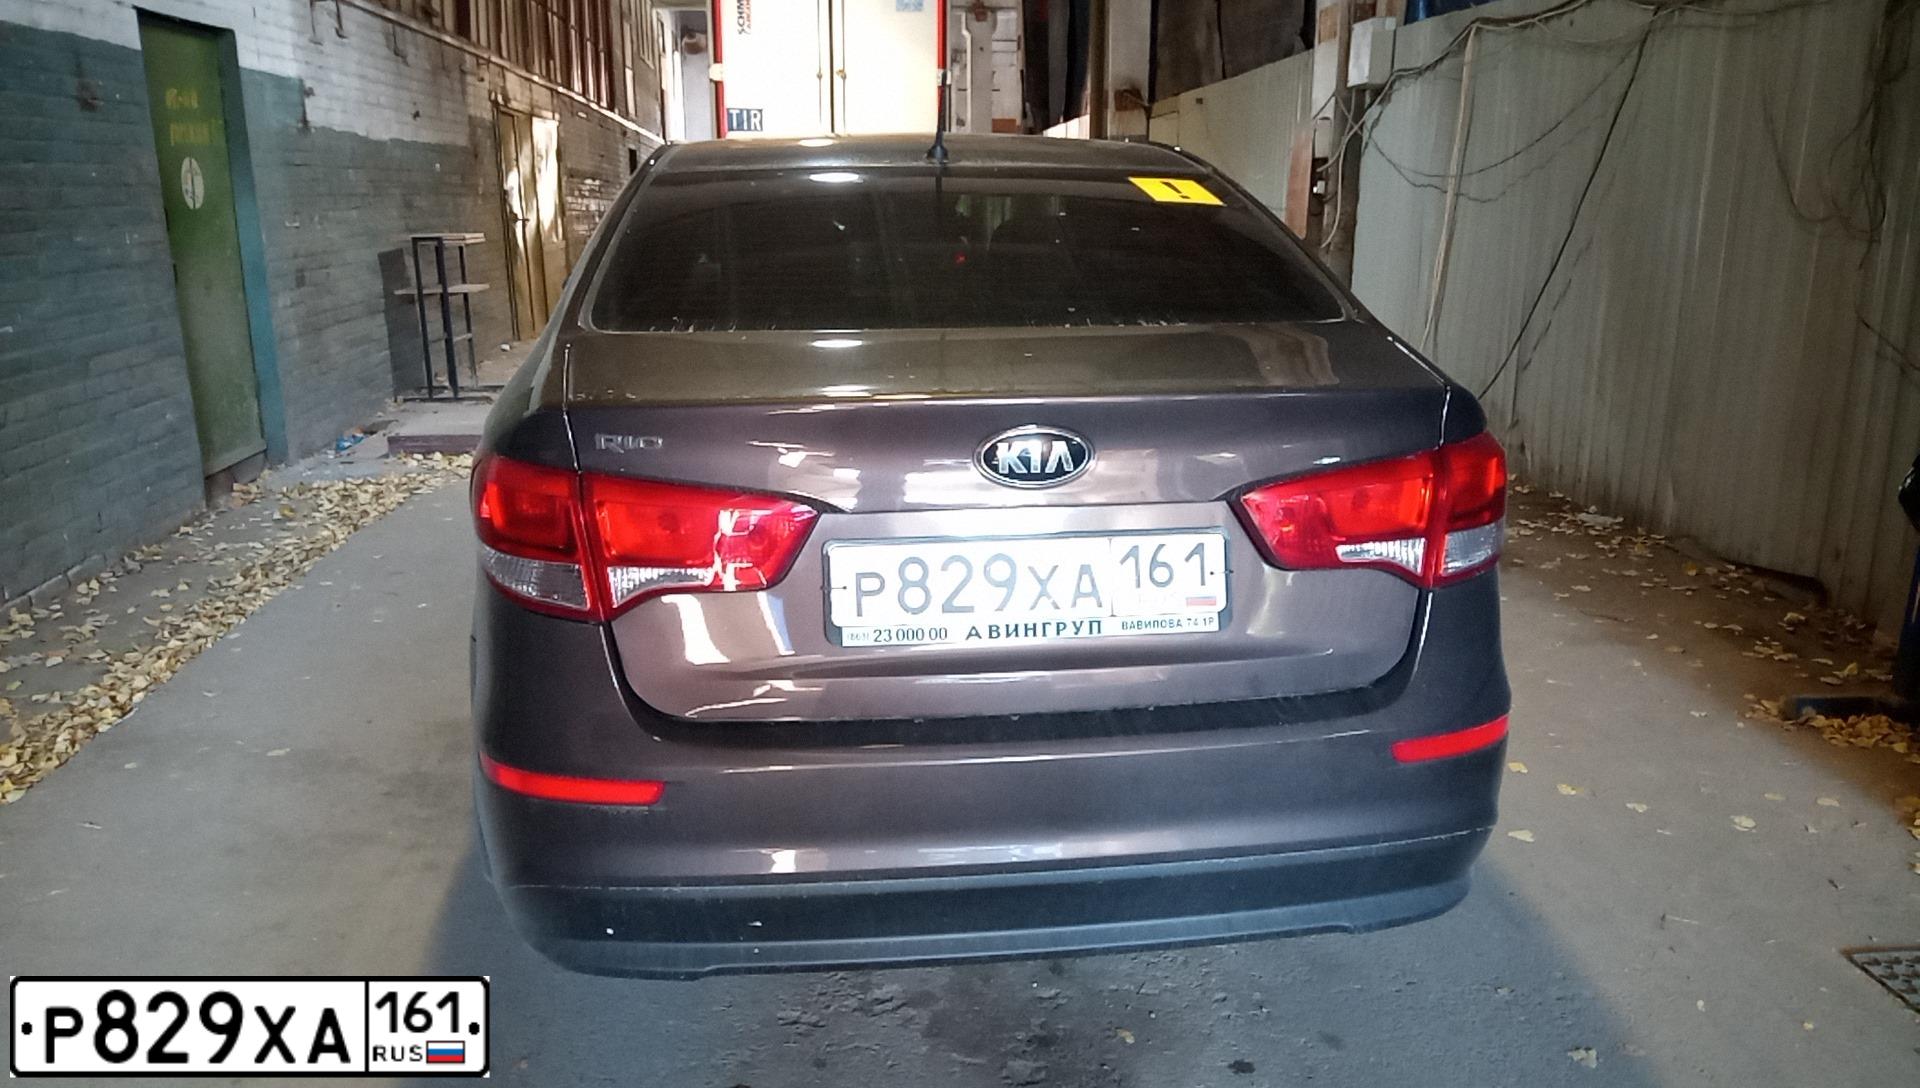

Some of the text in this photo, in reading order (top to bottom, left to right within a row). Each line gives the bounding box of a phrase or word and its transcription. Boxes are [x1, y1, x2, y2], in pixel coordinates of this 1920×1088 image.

[727, 108, 762, 131] TIR
[594, 433, 663, 454] RIO
[997, 440, 1074, 474] KIA
[855, 542, 1207, 617] Р829ХА 161
[965, 620, 1102, 640] АВИНГРУП
